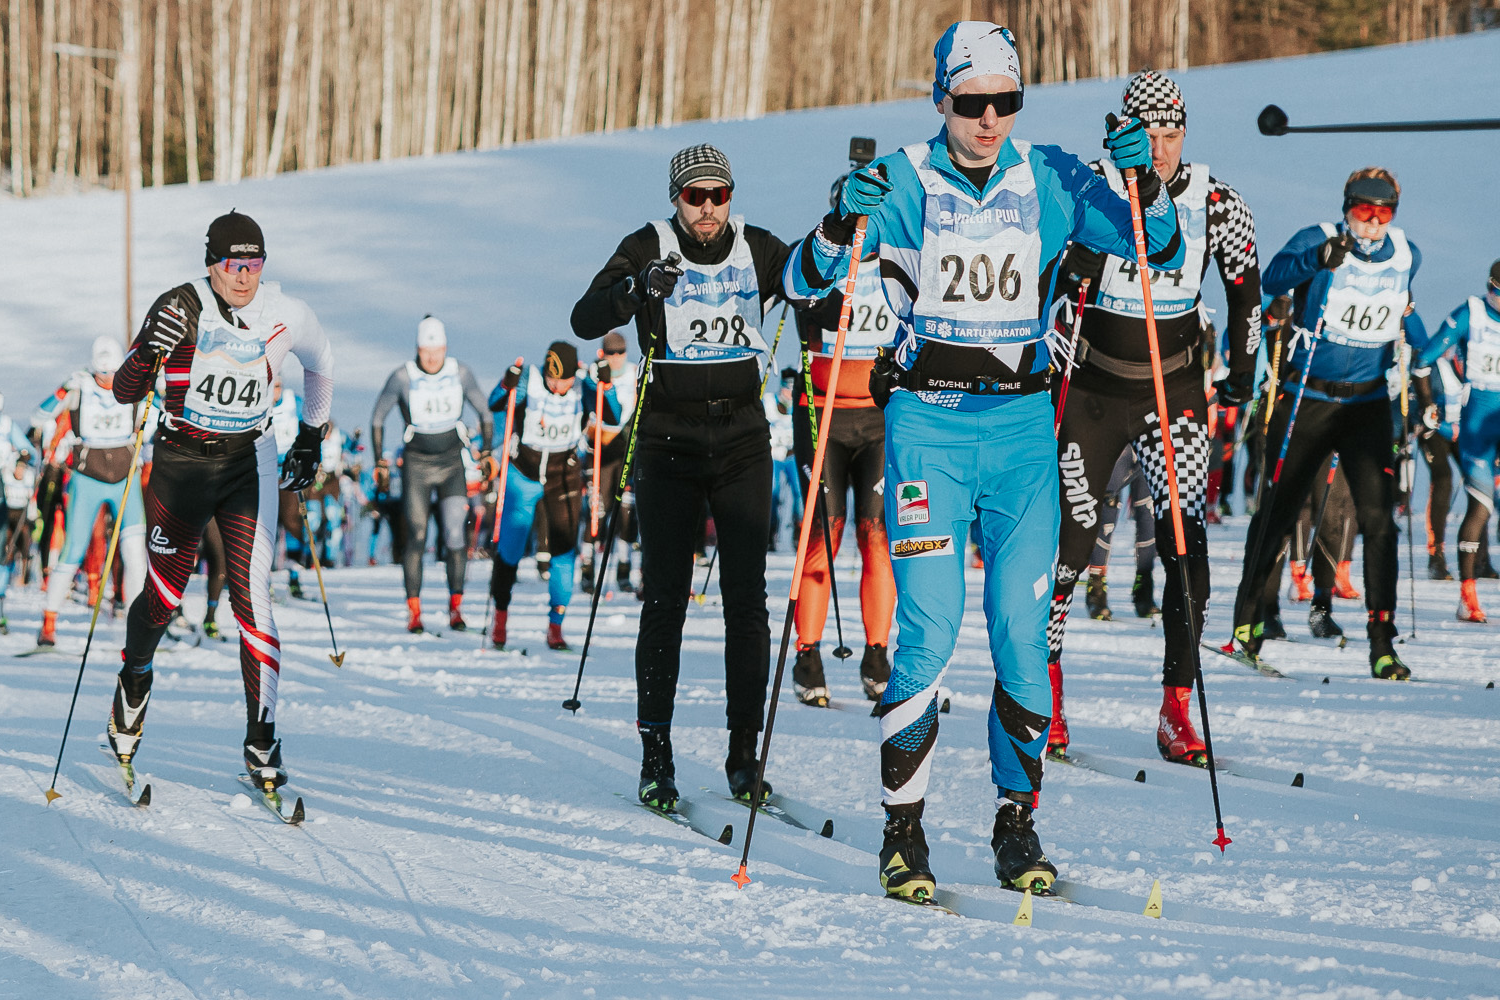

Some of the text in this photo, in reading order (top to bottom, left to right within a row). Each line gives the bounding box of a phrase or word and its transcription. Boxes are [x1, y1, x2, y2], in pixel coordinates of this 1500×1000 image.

[1139, 109, 1183, 122] sparta
[995, 208, 1020, 224] PUU
[940, 253, 1022, 303] 206
[1118, 260, 1184, 287] 44
[848, 304, 889, 332] 26
[1153, 302, 1187, 313] MARATON
[1340, 304, 1390, 331] 462
[689, 314, 752, 347] 328
[925, 320, 1031, 338] 50 TARTU MARATON
[1246, 303, 1262, 355] sparta
[195, 373, 262, 408] 404
[211, 419, 235, 428] TARTU
[1058, 441, 1099, 530] sparta
[915, 513, 928, 521] PUU
[894, 539, 943, 553] skiwax
